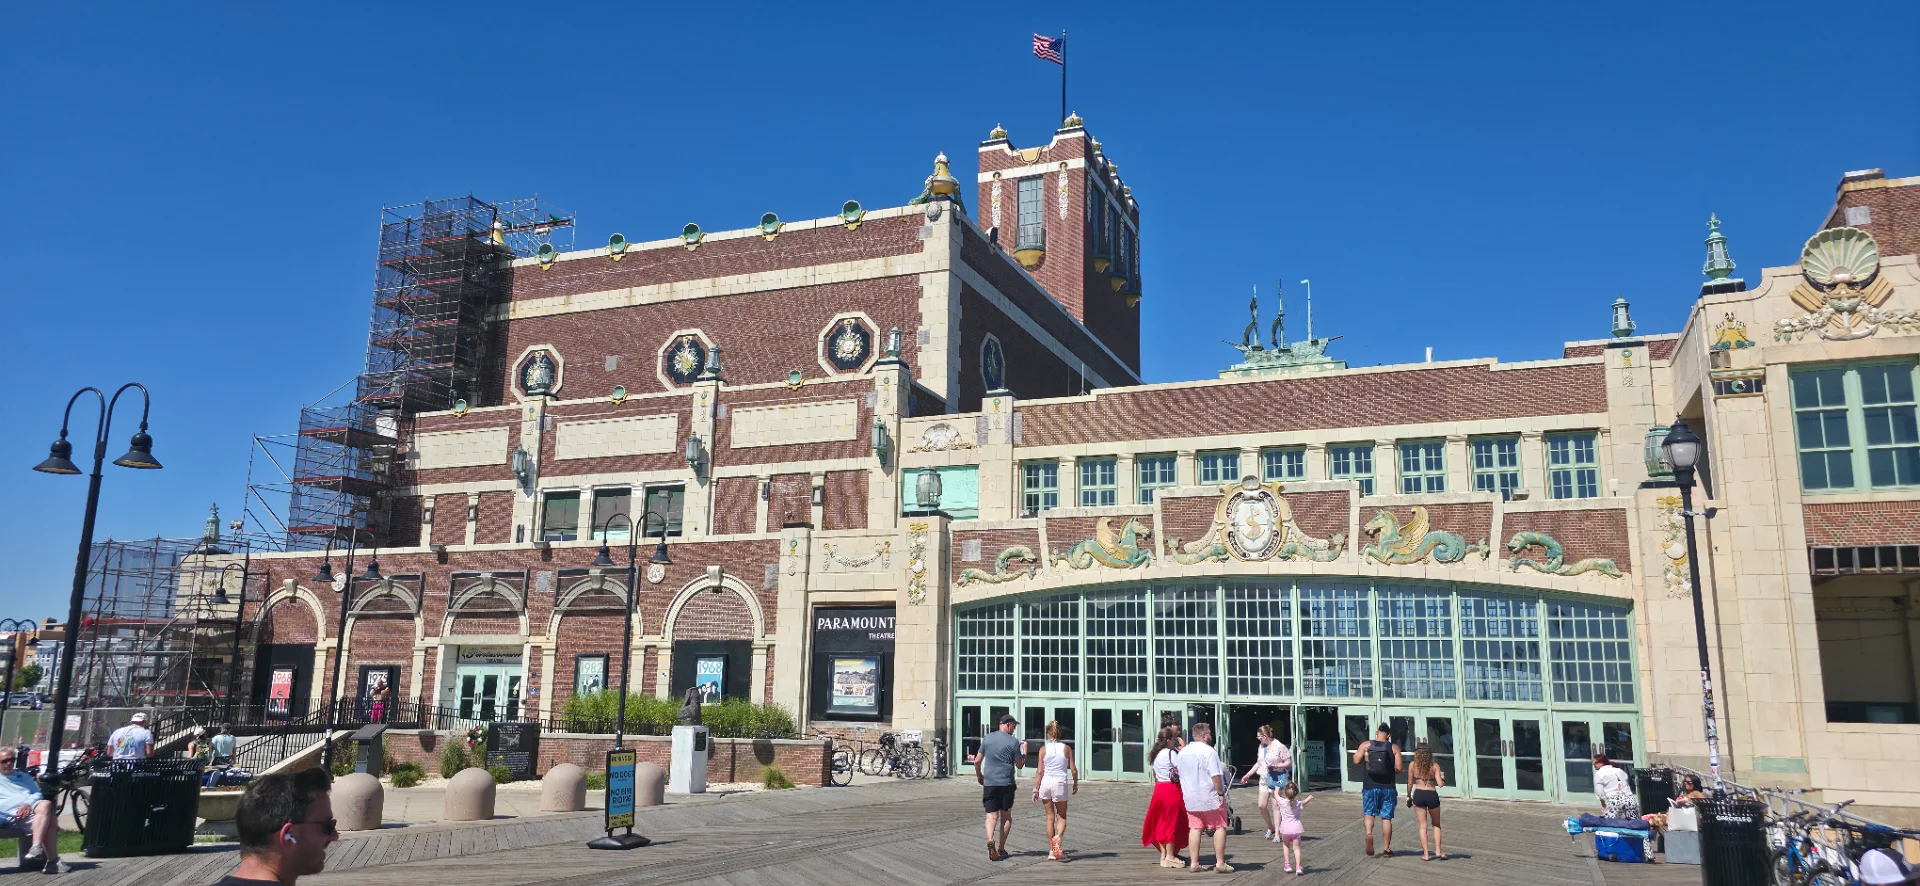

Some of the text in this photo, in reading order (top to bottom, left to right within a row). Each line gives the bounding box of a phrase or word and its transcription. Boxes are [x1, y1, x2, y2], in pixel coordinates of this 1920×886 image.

[817, 616, 896, 630] PARAMOUNT
[580, 662, 603, 674] 1982
[698, 661, 722, 674] 1968
[273, 672, 292, 684] 1968
[610, 771, 618, 779] NO
[611, 787, 632, 796] NO BIKE
[612, 795, 632, 804] RIDING
